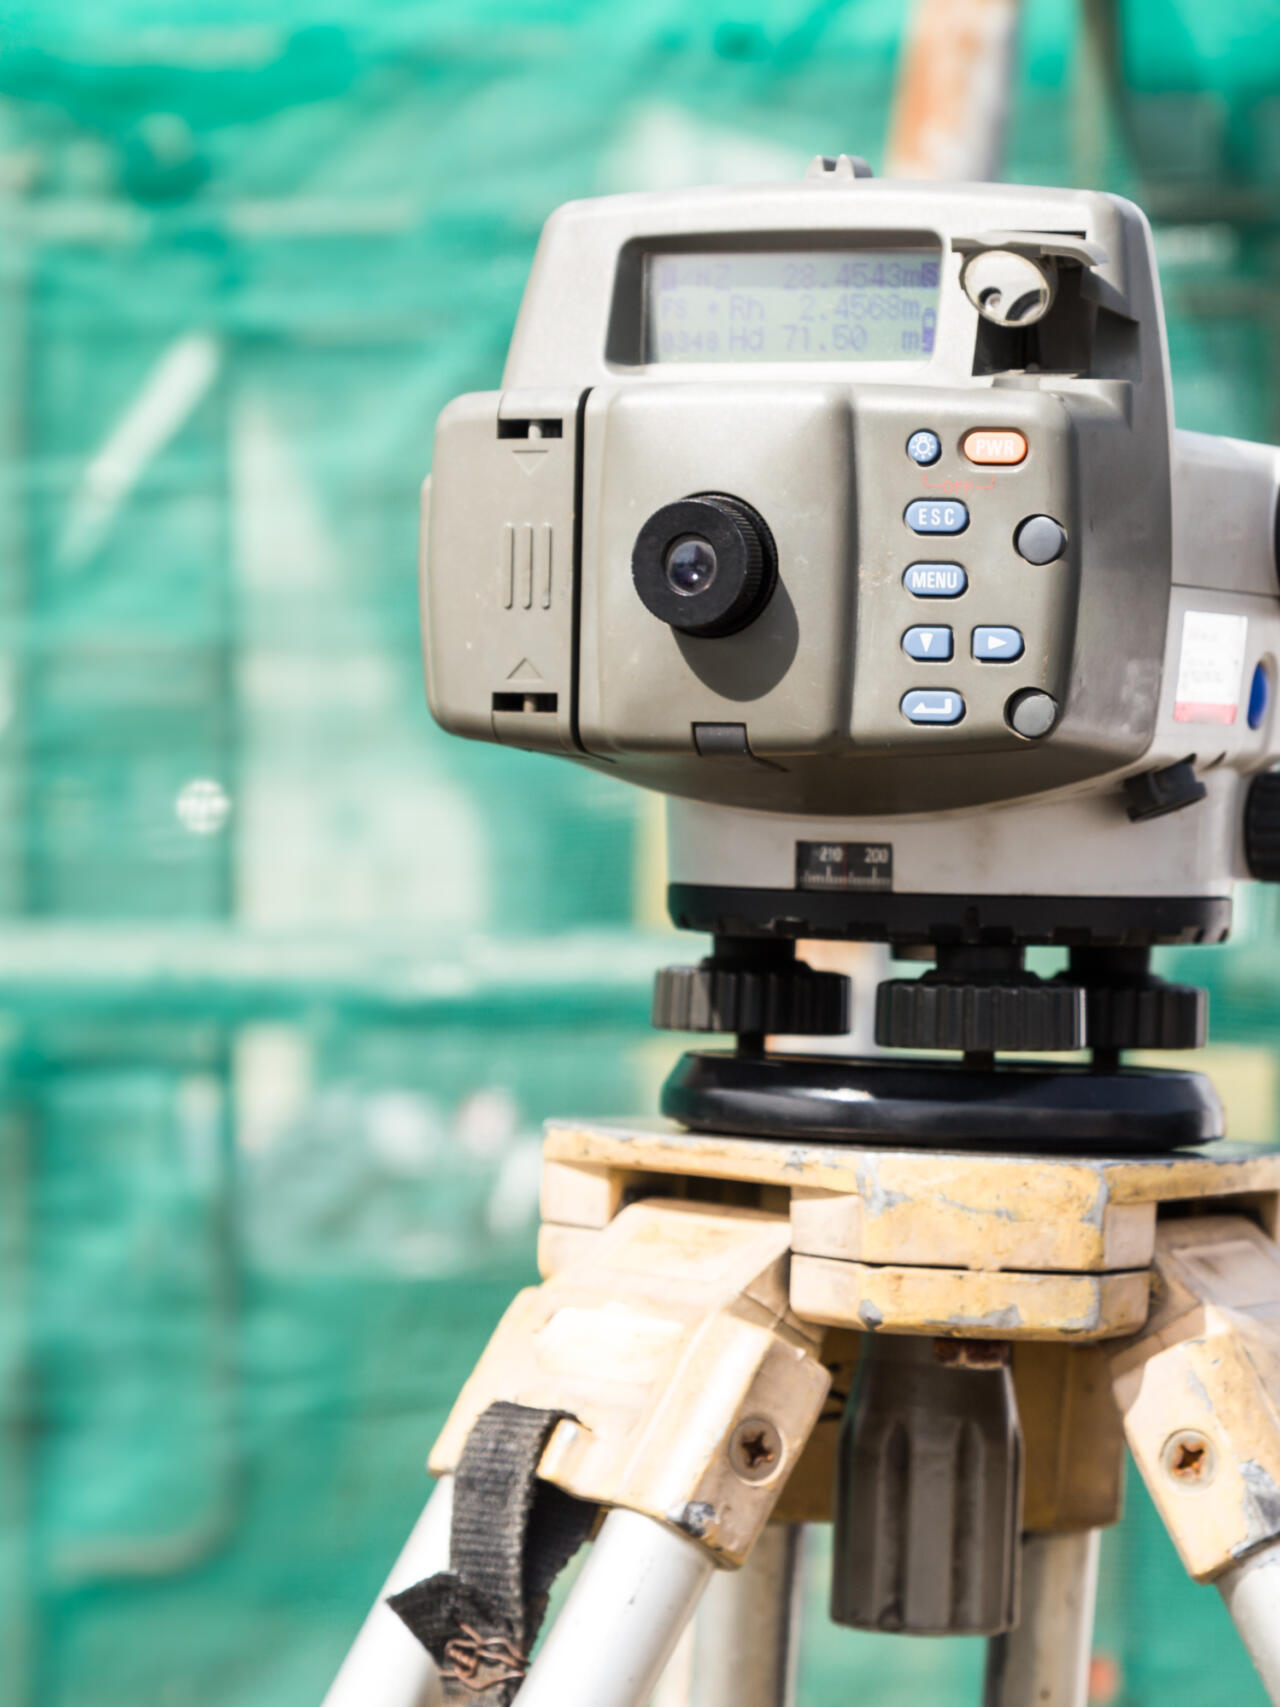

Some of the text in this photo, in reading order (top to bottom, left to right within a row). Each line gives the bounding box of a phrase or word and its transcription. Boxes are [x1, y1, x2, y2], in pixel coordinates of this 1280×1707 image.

[729, 295, 765, 321] Rh
[729, 325, 765, 351] Hd
[975, 439, 1015, 457] PWR
[942, 479, 973, 493] OFF
[918, 508, 954, 526] ESC
[912, 571, 958, 589] MENU
[864, 848, 889, 864] 200
